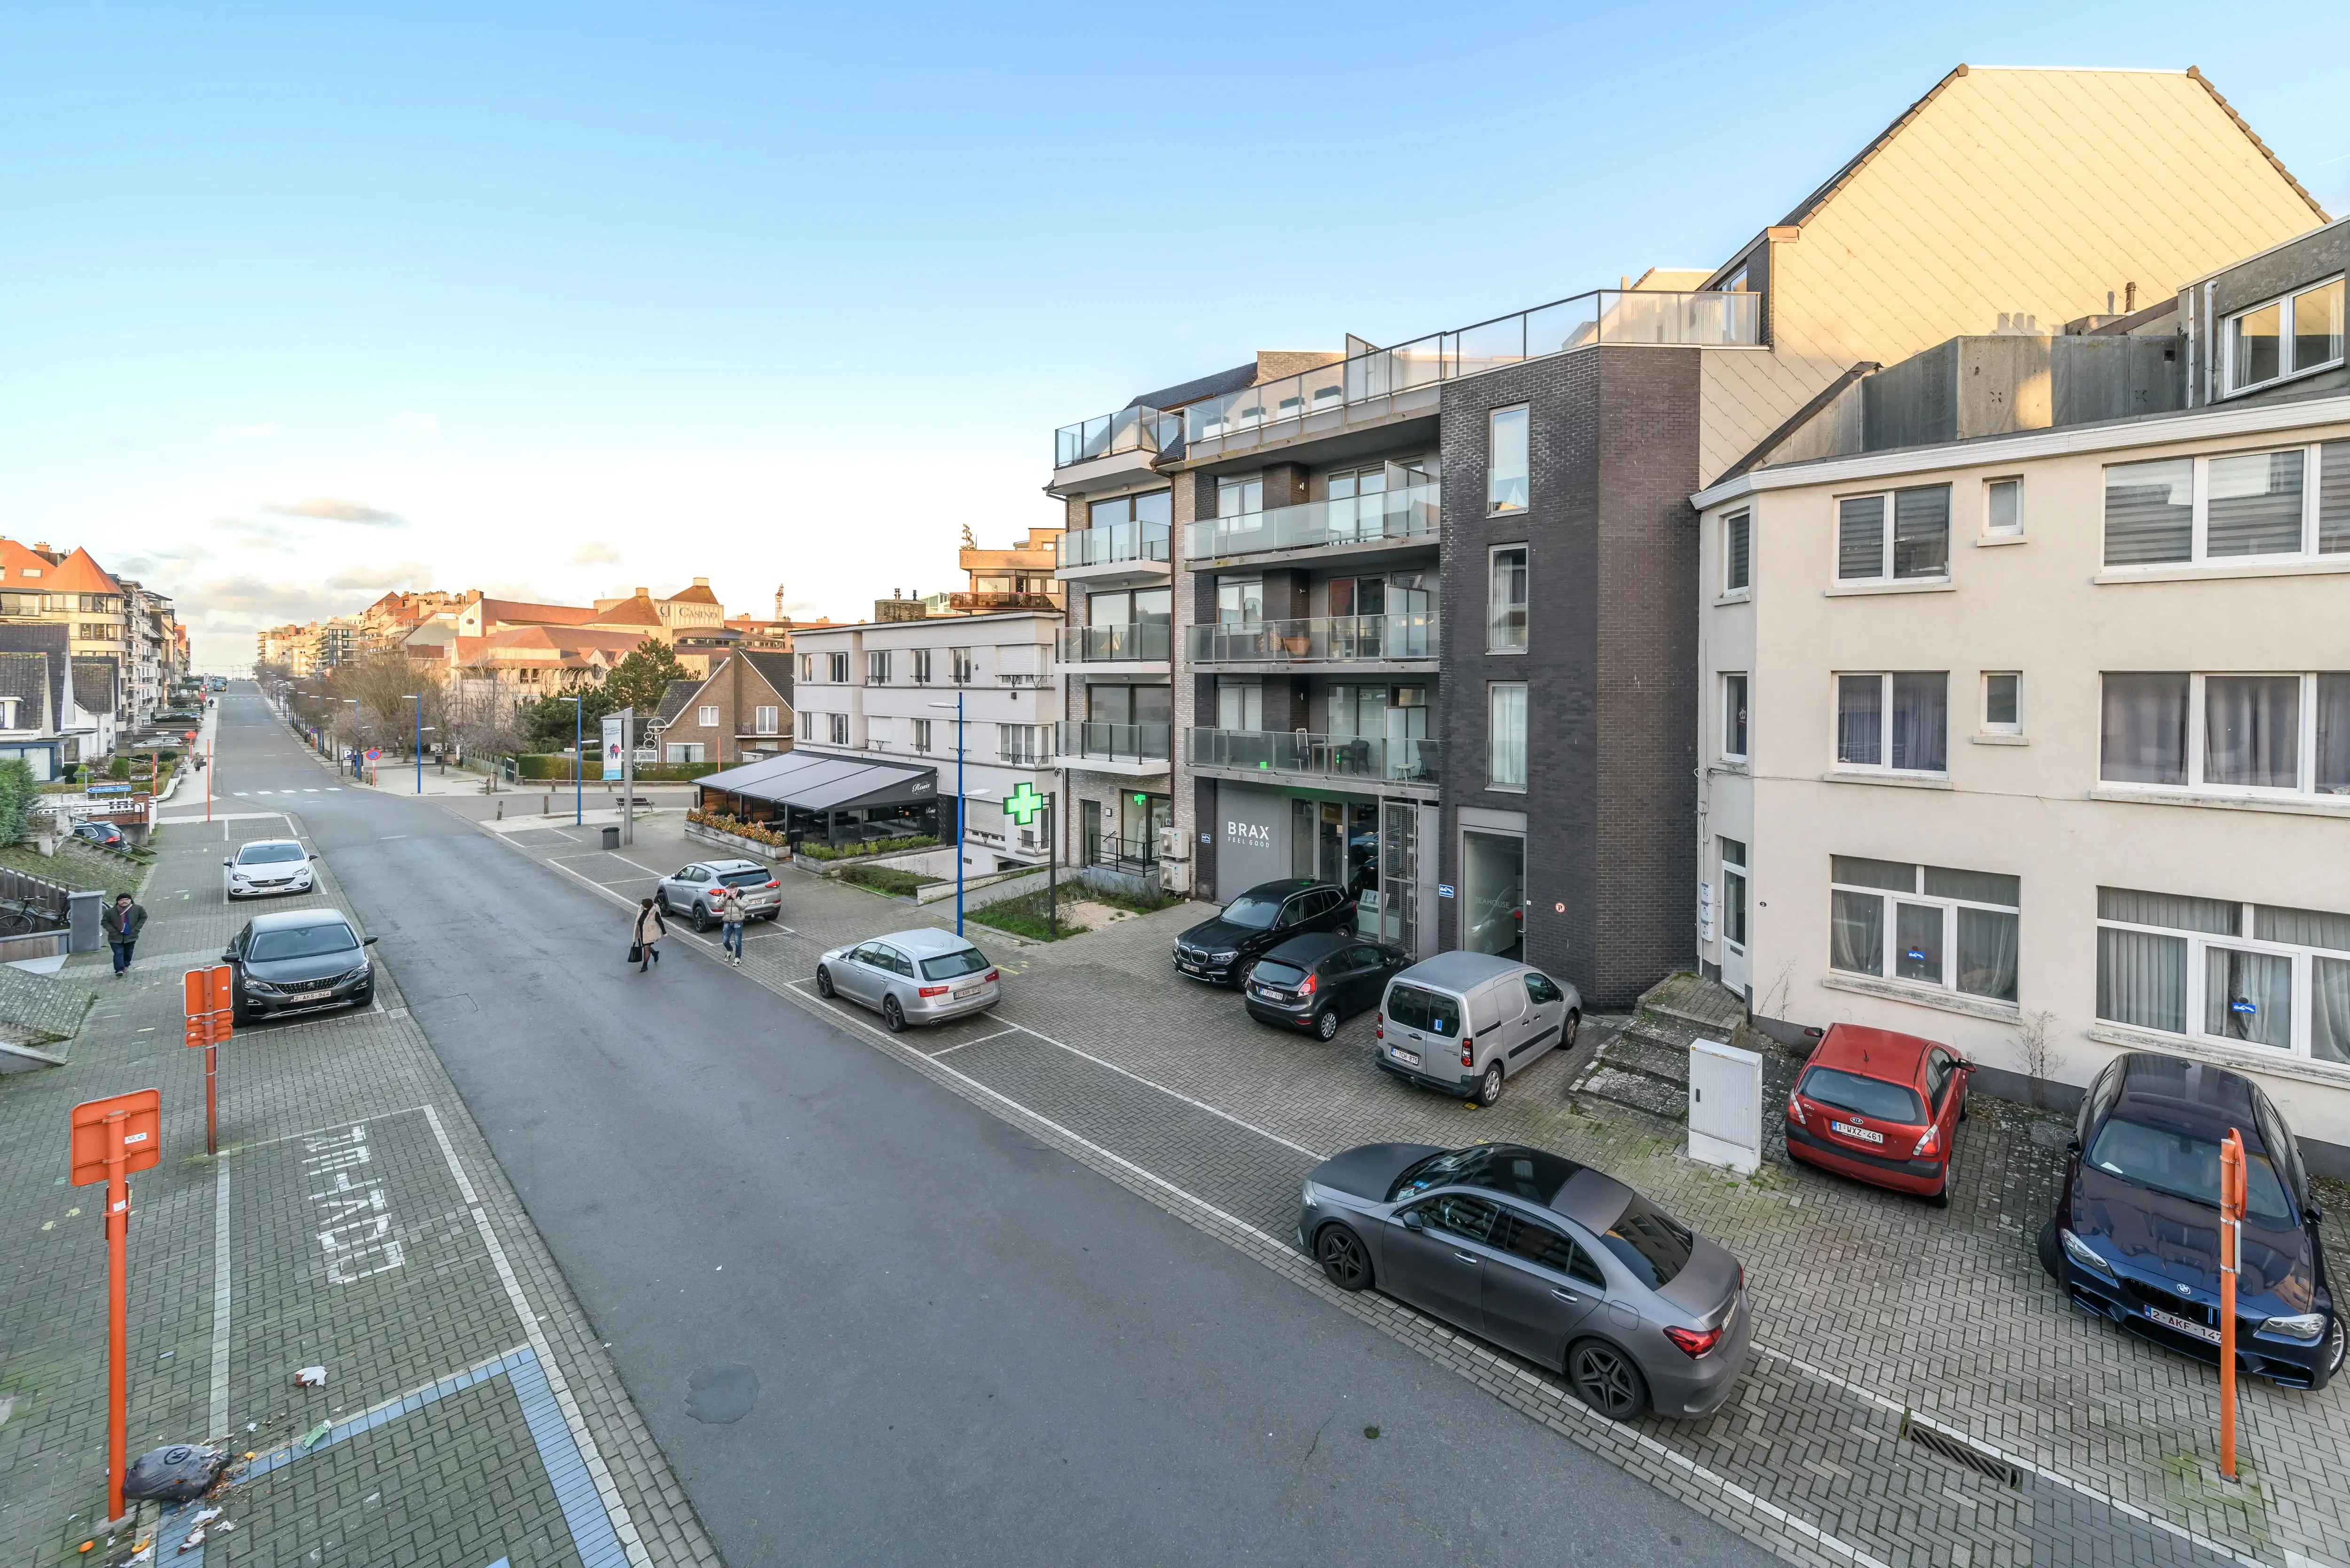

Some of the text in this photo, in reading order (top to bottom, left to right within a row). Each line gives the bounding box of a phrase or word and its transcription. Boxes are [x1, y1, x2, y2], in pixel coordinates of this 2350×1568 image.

[679, 607, 718, 619] CASINO
[912, 783, 931, 792] Rosa
[1228, 821, 1269, 840] BRAX
[1474, 896, 1510, 909] SEAHOUSE
[295, 992, 329, 1001] 2-AKS-944
[1263, 990, 1282, 999] 1-PSY-019
[1394, 1050, 1418, 1063] 1-TCH-875
[1838, 1123, 1881, 1142] 1-WXZ-461
